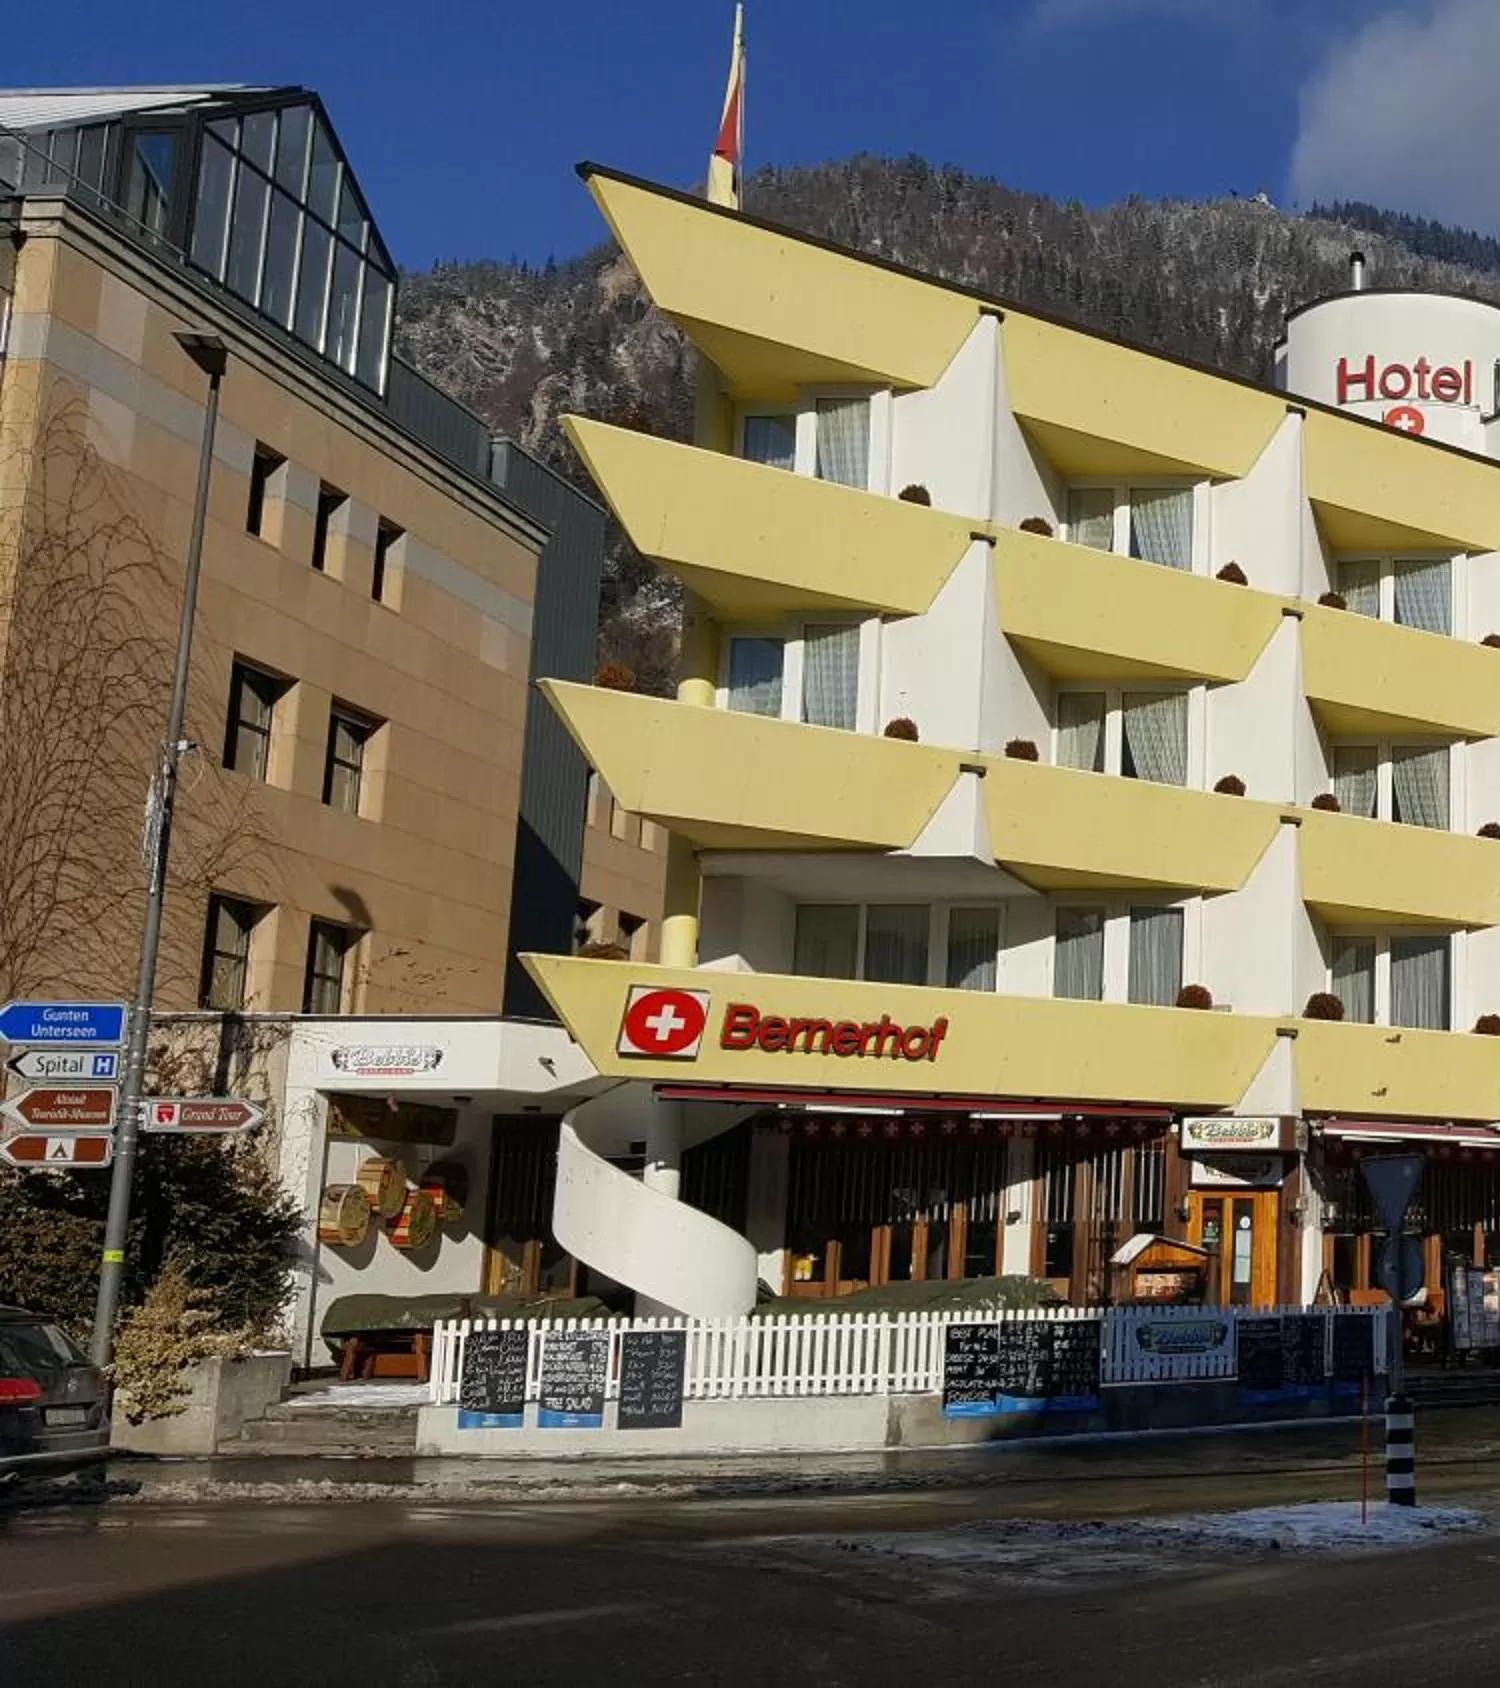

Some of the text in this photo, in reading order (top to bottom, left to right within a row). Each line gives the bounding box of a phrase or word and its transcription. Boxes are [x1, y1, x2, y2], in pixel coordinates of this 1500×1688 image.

[1336, 354, 1473, 405] Hotel
[43, 1009, 89, 1022] Gunten
[31, 1025, 97, 1037] Unterseen
[720, 1002, 949, 1062] Bernerhof
[35, 1056, 84, 1076] Spital
[96, 1058, 111, 1073] H
[181, 1107, 243, 1121] Grand Tour
